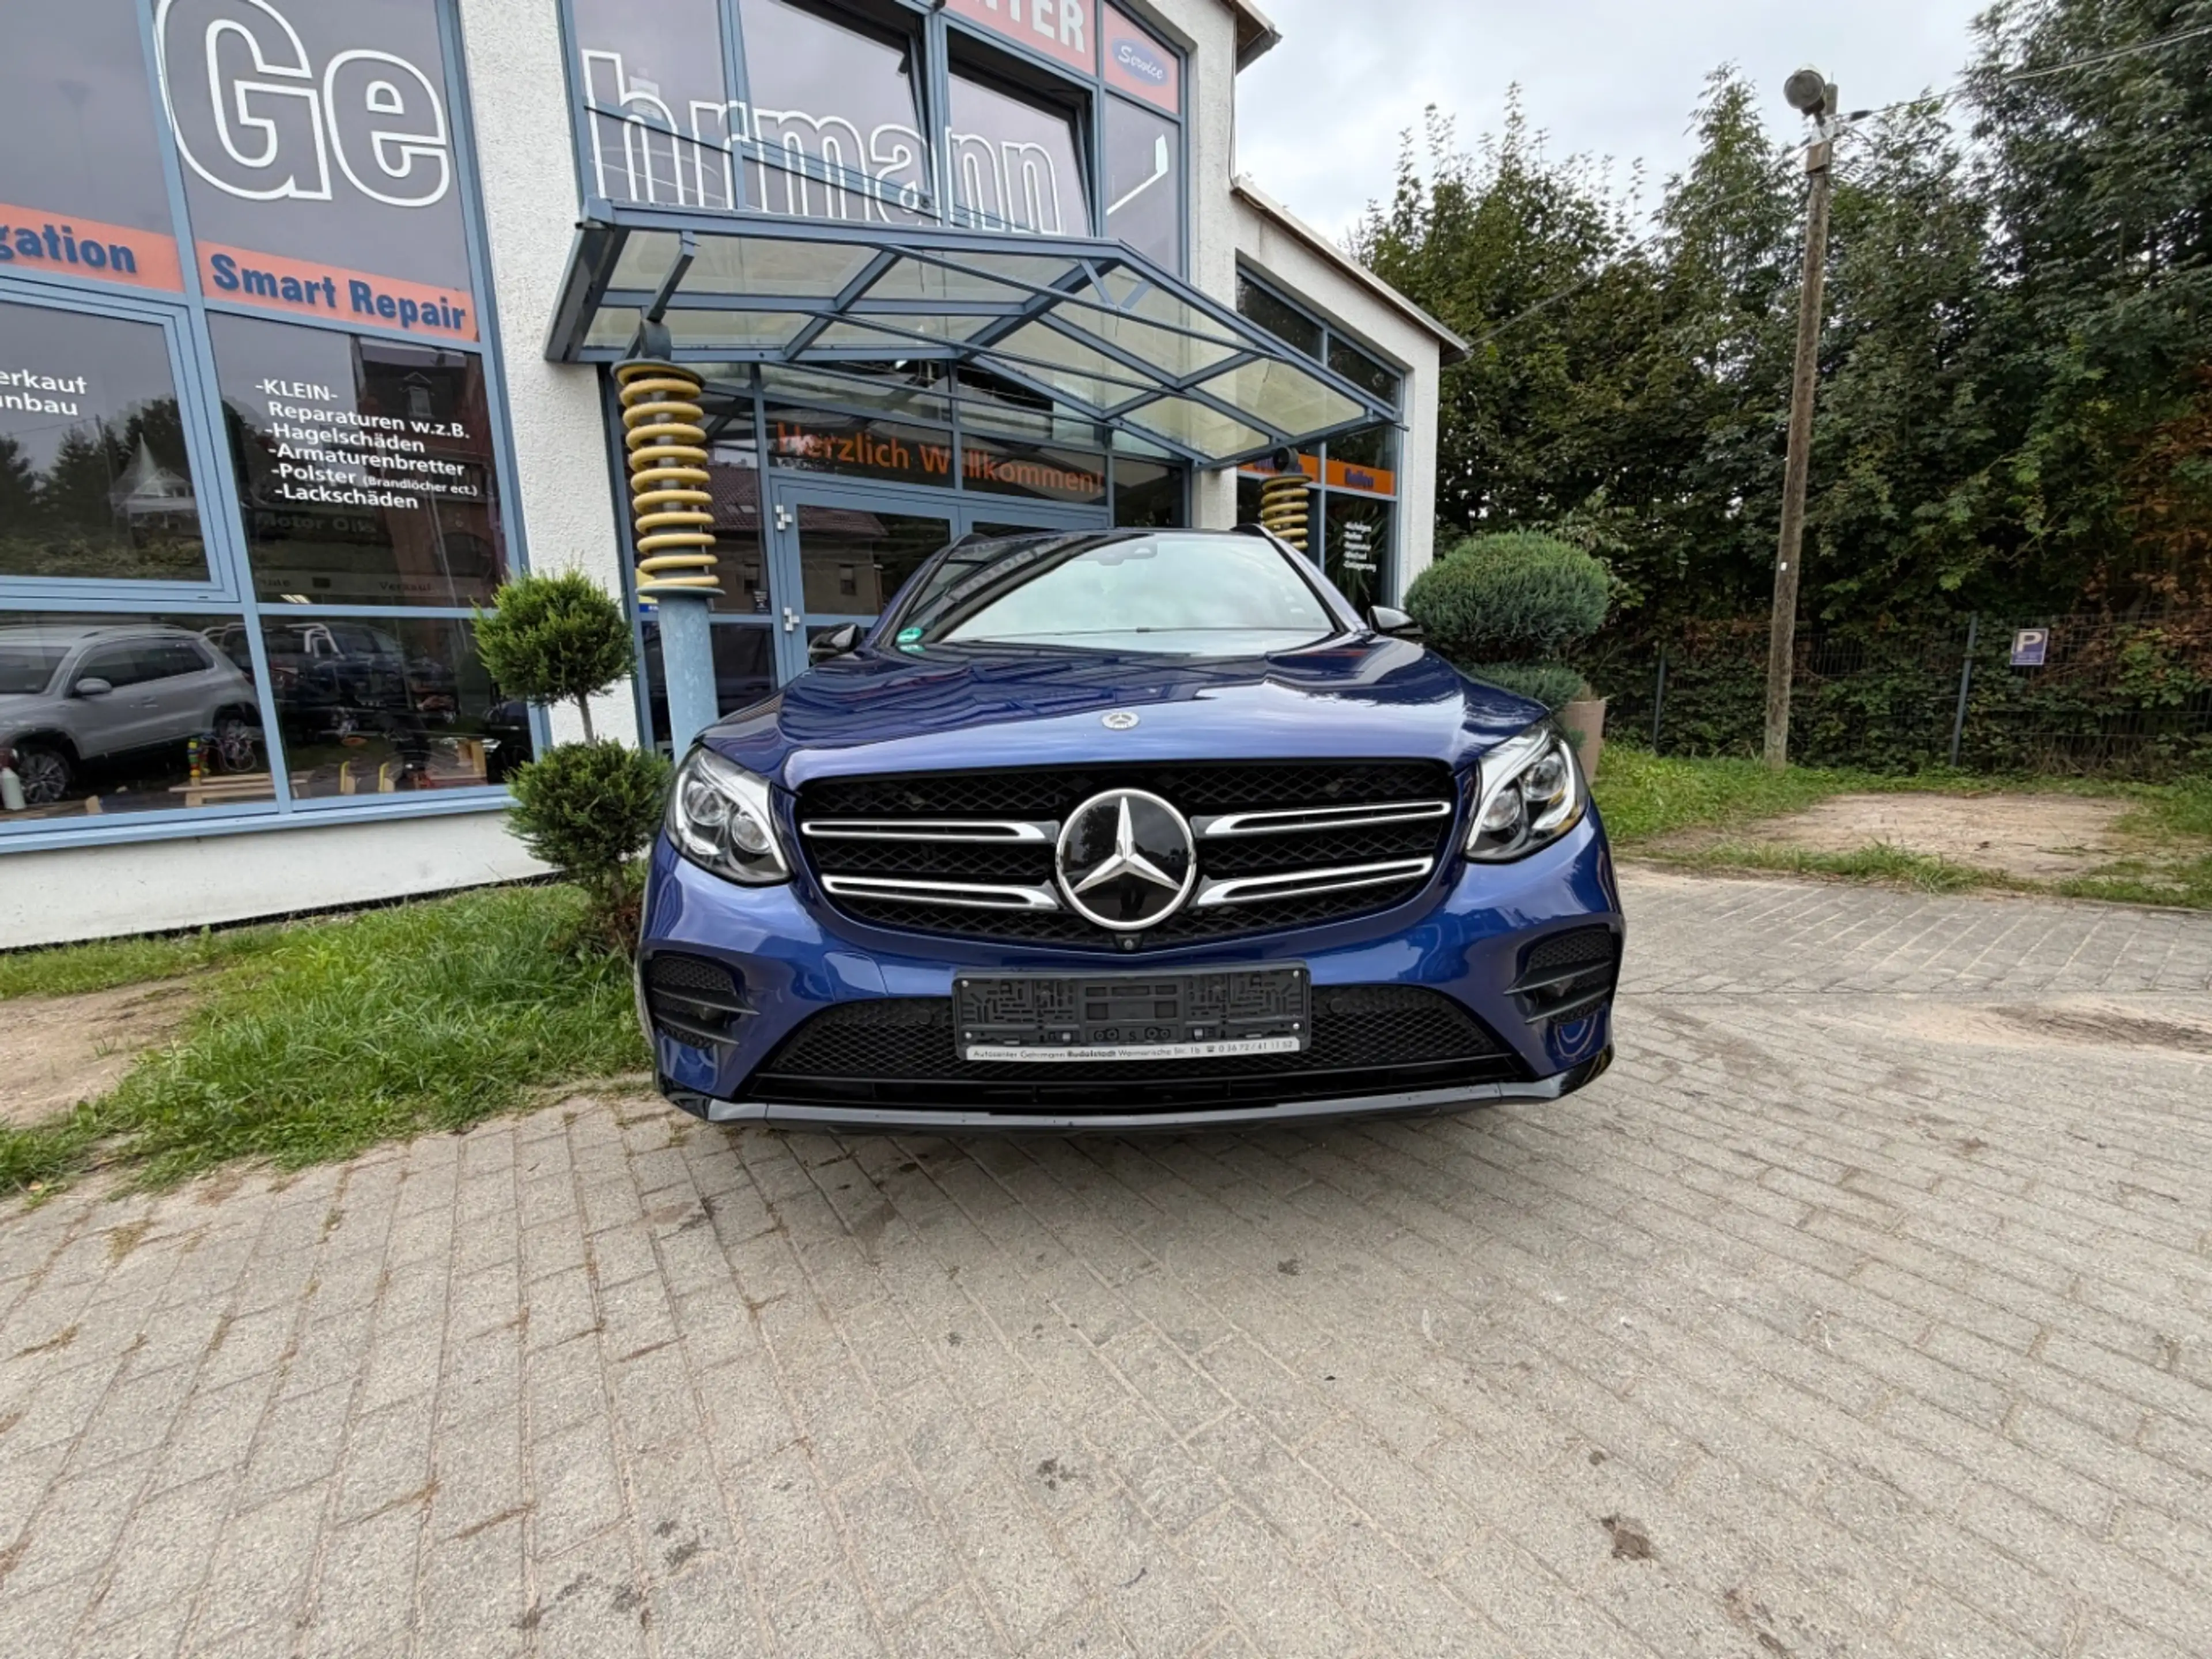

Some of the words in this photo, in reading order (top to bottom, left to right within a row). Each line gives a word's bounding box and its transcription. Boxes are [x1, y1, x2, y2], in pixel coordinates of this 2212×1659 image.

[152, 0, 450, 207] Ge
[210, 253, 336, 308] Smart
[349, 279, 466, 329] Repair
[255, 378, 338, 401] -KLEIN-
[268, 400, 405, 431] Reparaturen
[410, 421, 470, 439] w.z.B.
[264, 422, 425, 453] -Hagelschäden
[777, 421, 909, 469] Herzlich
[268, 443, 465, 476] -Armaturenbretter
[271, 463, 357, 484] -Polster
[362, 475, 447, 493] (Brandlöcher
[275, 483, 419, 509] -Lackschäden
[2018, 631, 2043, 652] P
